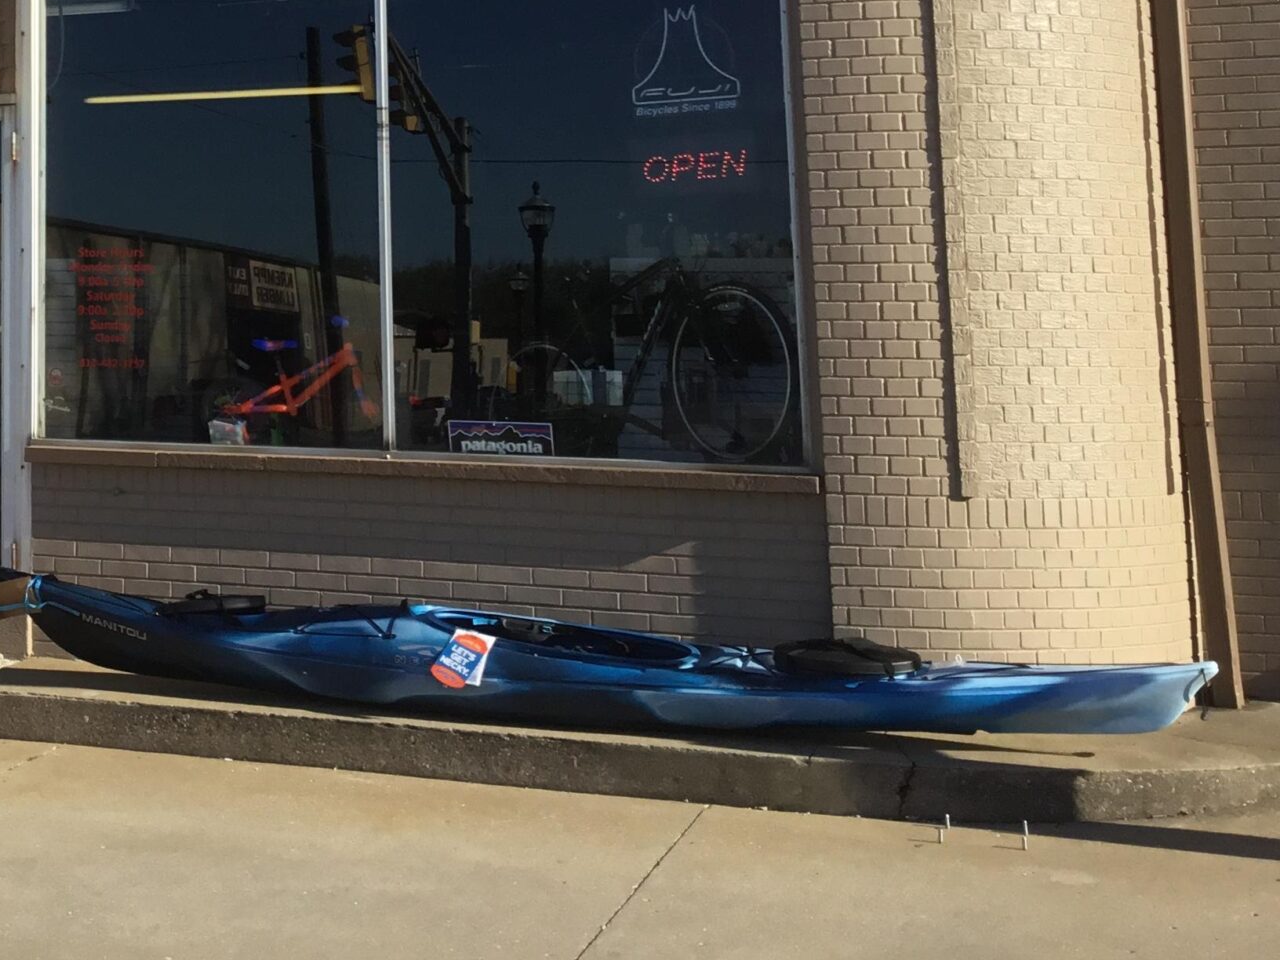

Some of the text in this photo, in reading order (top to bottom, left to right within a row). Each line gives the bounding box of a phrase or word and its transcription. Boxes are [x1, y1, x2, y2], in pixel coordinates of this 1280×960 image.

[636, 103, 679, 117] Bicycles
[681, 101, 710, 113] Since
[643, 149, 747, 182] OPEN
[460, 439, 544, 455] patagonia
[80, 612, 147, 641] MANITOU
[449, 653, 470, 667] GET
[451, 644, 477, 662] LET'S
